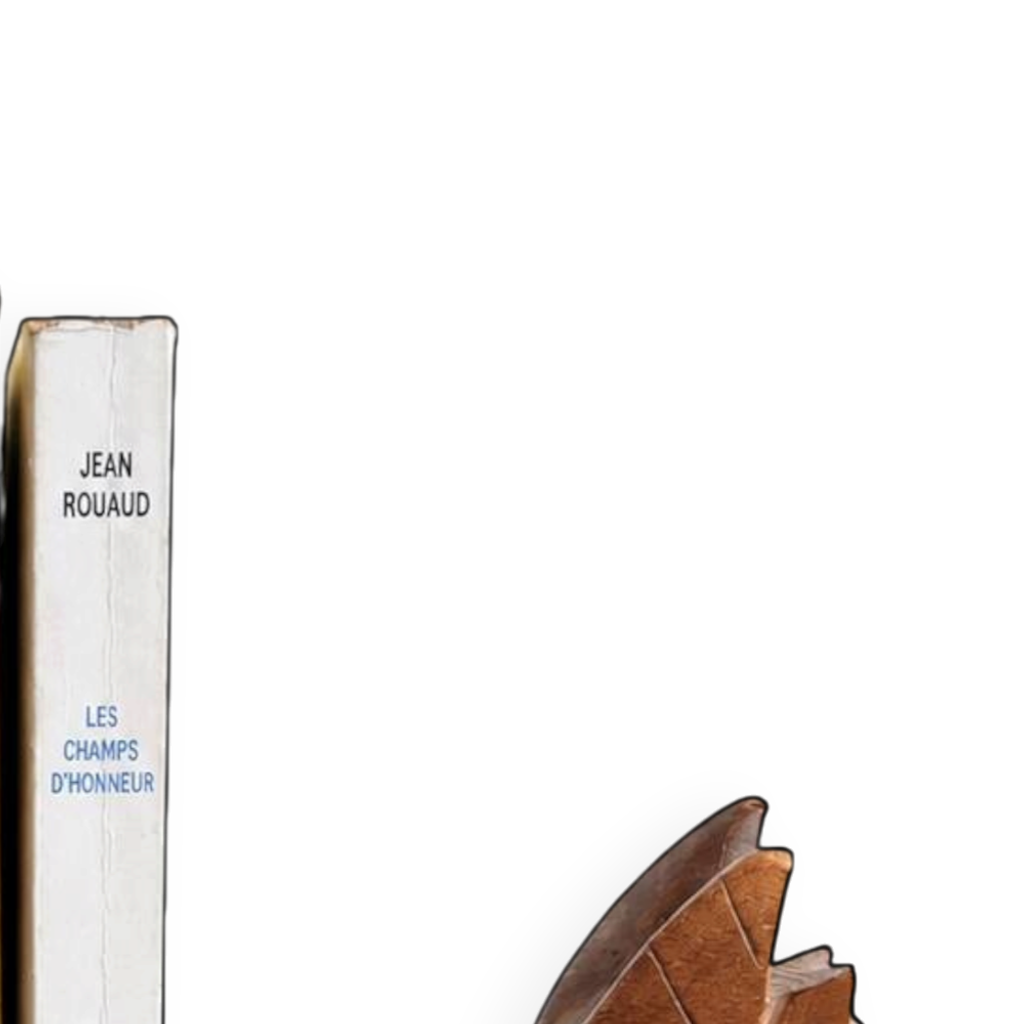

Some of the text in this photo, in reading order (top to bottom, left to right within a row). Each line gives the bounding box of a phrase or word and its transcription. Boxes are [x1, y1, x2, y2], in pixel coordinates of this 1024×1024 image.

[80, 451, 133, 478] JEAN
[62, 491, 151, 518] ROUAUD
[85, 705, 118, 728] LES
[63, 738, 139, 762] CHAMPS
[51, 771, 155, 794] D'HONNEUR
